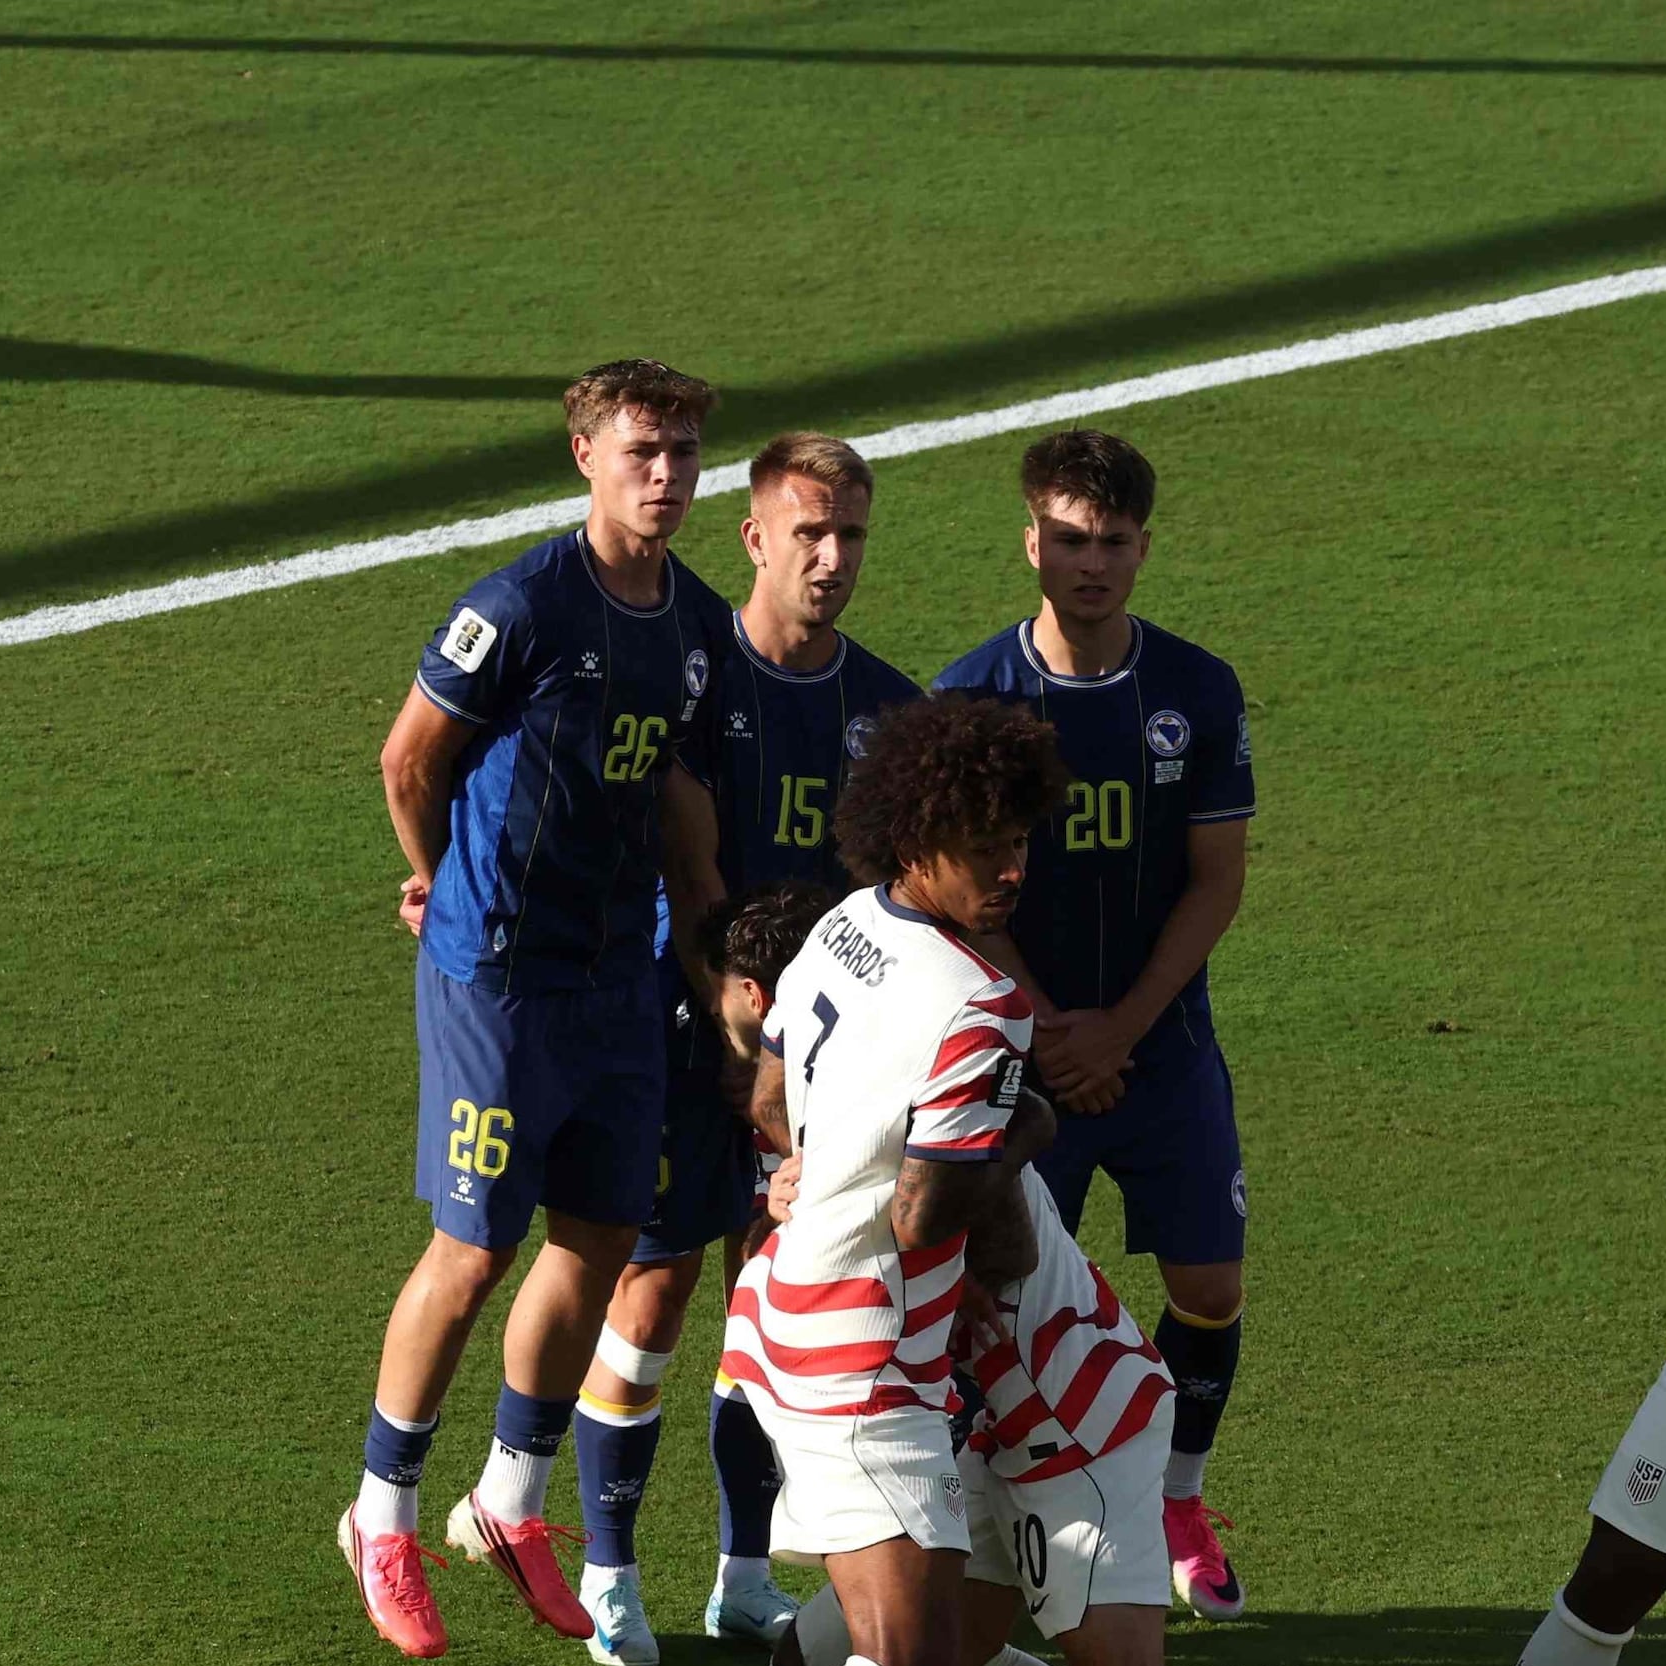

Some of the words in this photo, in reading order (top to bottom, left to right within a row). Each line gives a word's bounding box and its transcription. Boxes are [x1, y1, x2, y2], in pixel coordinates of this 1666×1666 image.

[573, 670, 605, 680] KELME
[723, 729, 755, 740] KELME
[773, 774, 828, 849] 15
[1066, 779, 1133, 851] 20
[448, 1097, 517, 1180] 26
[944, 1475, 961, 1495] USA
[1635, 1457, 1663, 1482] USA
[1013, 1513, 1047, 1589] 10
